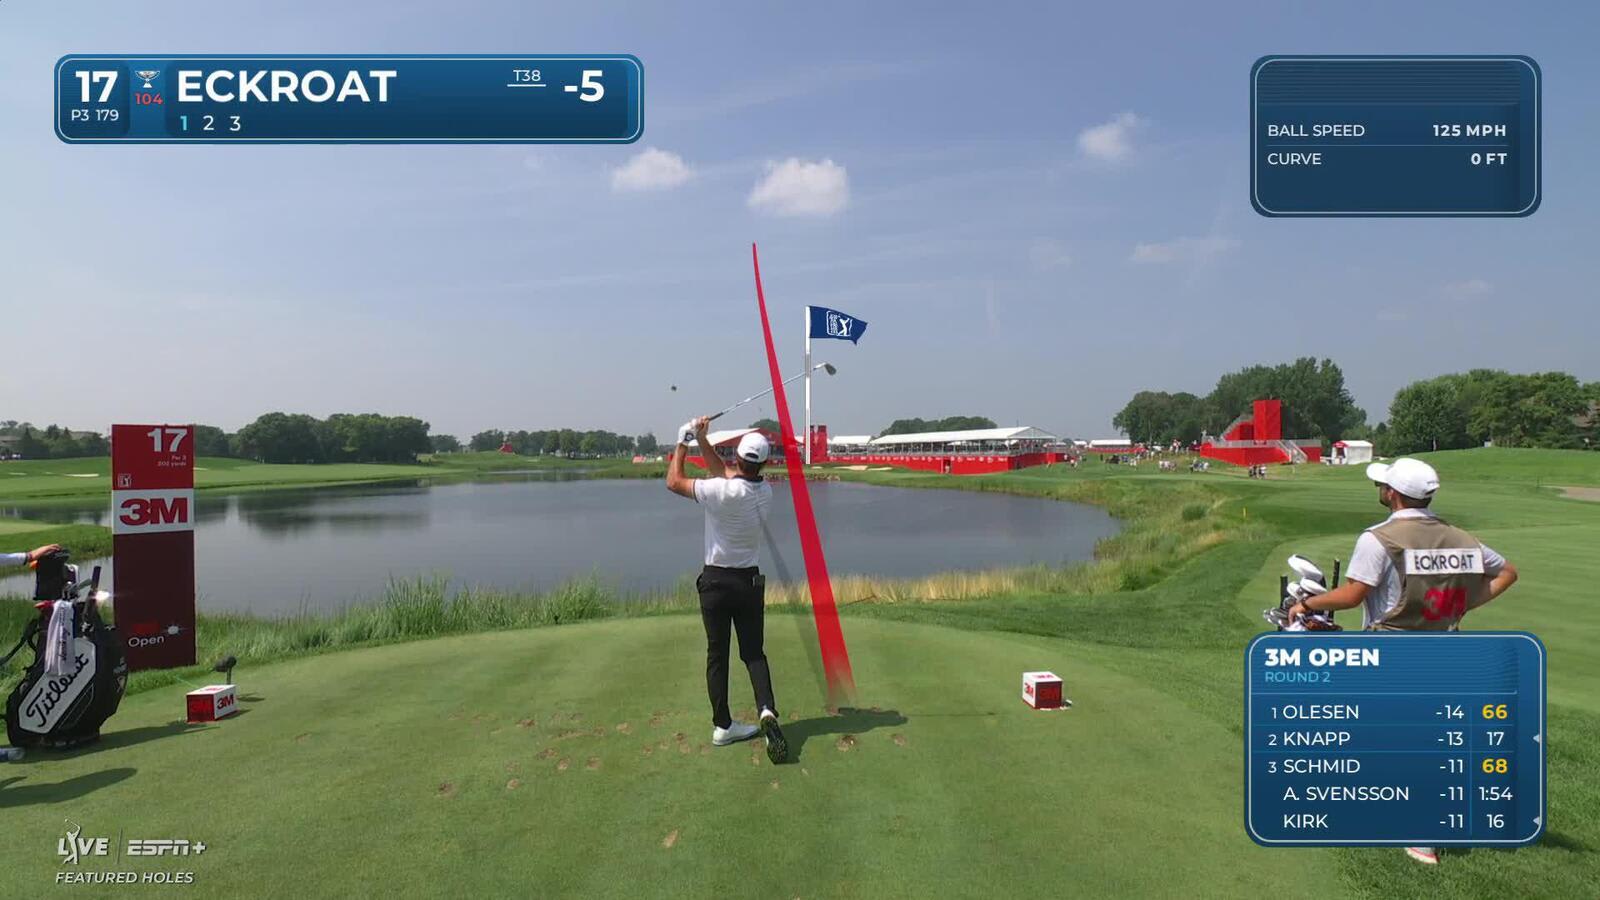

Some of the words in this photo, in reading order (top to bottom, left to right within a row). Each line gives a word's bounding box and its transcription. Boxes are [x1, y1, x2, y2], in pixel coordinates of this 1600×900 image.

[147, 428, 188, 452] 17
[119, 497, 188, 526] 3M
[1414, 554, 1475, 571] ECKROAT
[128, 635, 165, 648] Open
[217, 694, 234, 710] 3M
